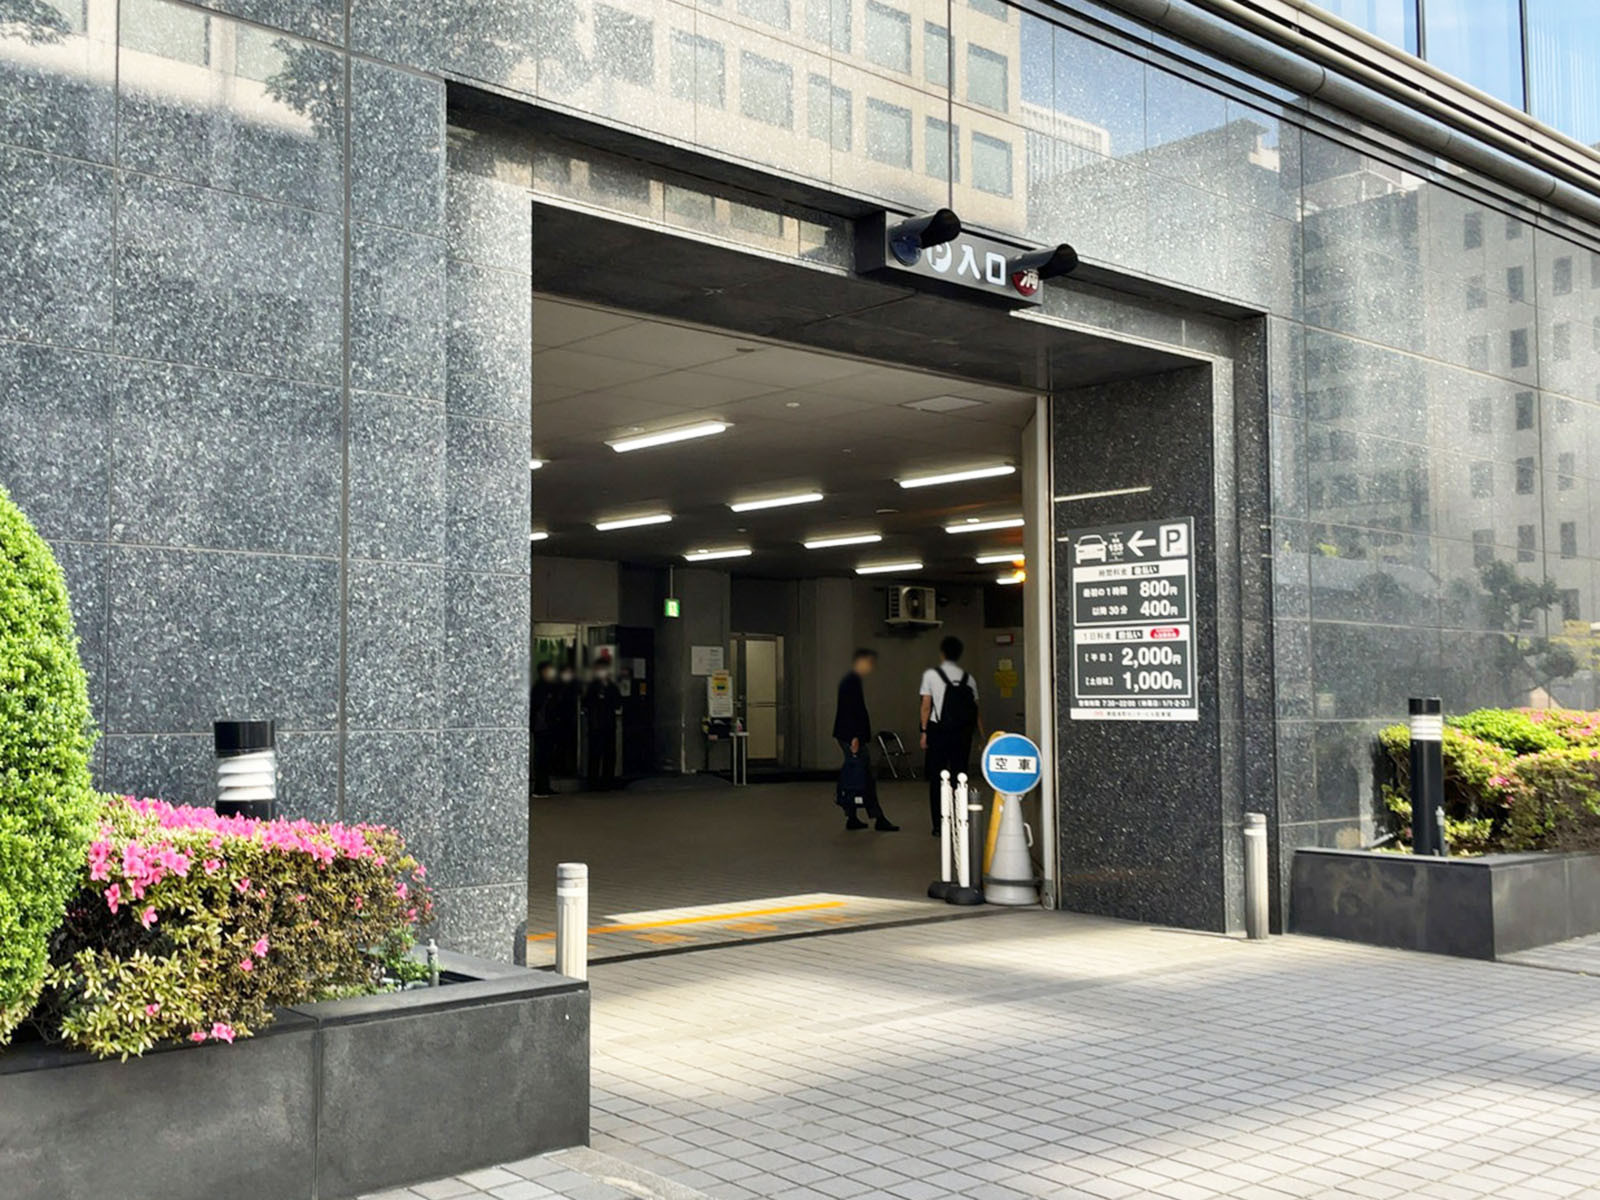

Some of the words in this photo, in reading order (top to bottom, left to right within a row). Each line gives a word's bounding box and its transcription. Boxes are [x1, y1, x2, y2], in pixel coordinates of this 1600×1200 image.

[957, 244, 1007, 287] 入口
[1165, 529, 1182, 552] P
[1139, 580, 1178, 597] 800円
[1139, 600, 1179, 616] 400円
[1121, 646, 1182, 669] 2,000円
[1122, 671, 1182, 693] 1,000円
[994, 757, 1031, 771] 空車
